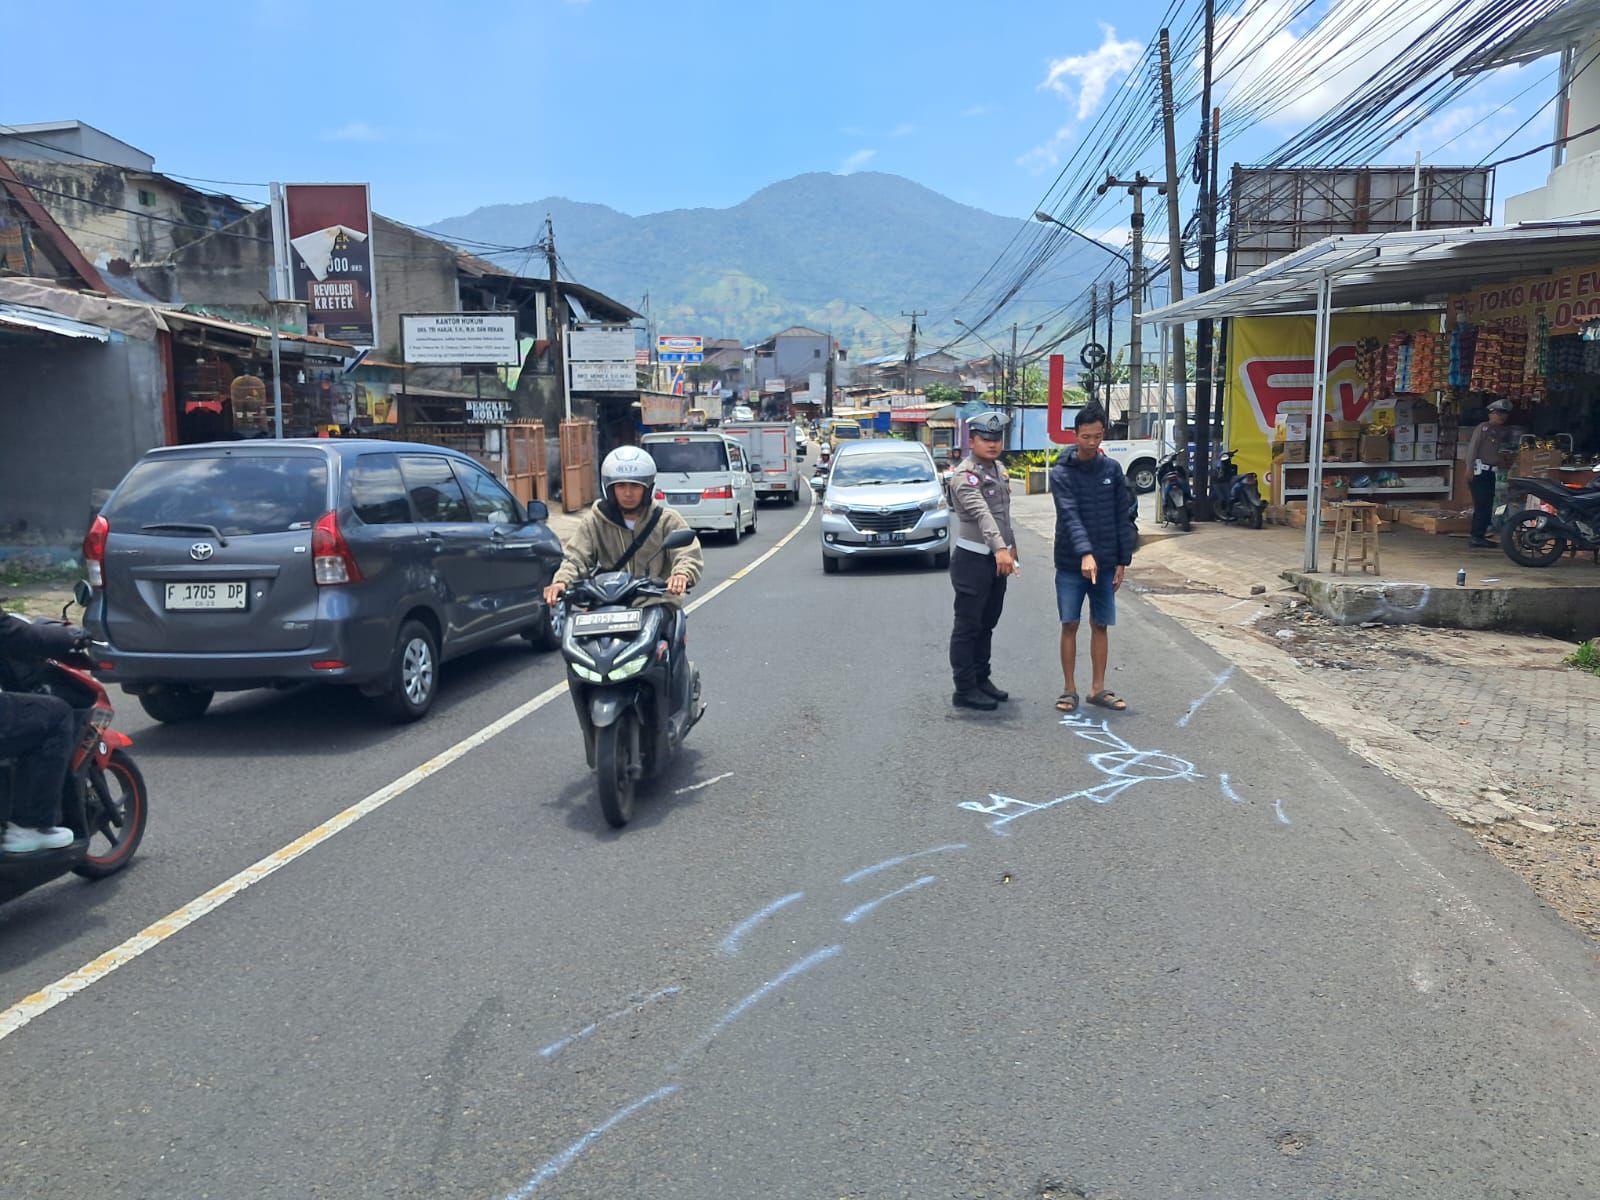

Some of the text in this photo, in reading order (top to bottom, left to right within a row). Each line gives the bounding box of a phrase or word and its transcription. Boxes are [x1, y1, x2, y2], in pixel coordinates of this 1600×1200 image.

[313, 282, 353, 297] REVOLUSI
[1480, 286, 1525, 311] TOKO
[1529, 277, 1572, 304] KUE
[314, 296, 354, 310] KRETEK
[465, 401, 512, 411] BENGKEL
[472, 411, 507, 420] MOBIL
[168, 584, 244, 600] F 1705 DP
